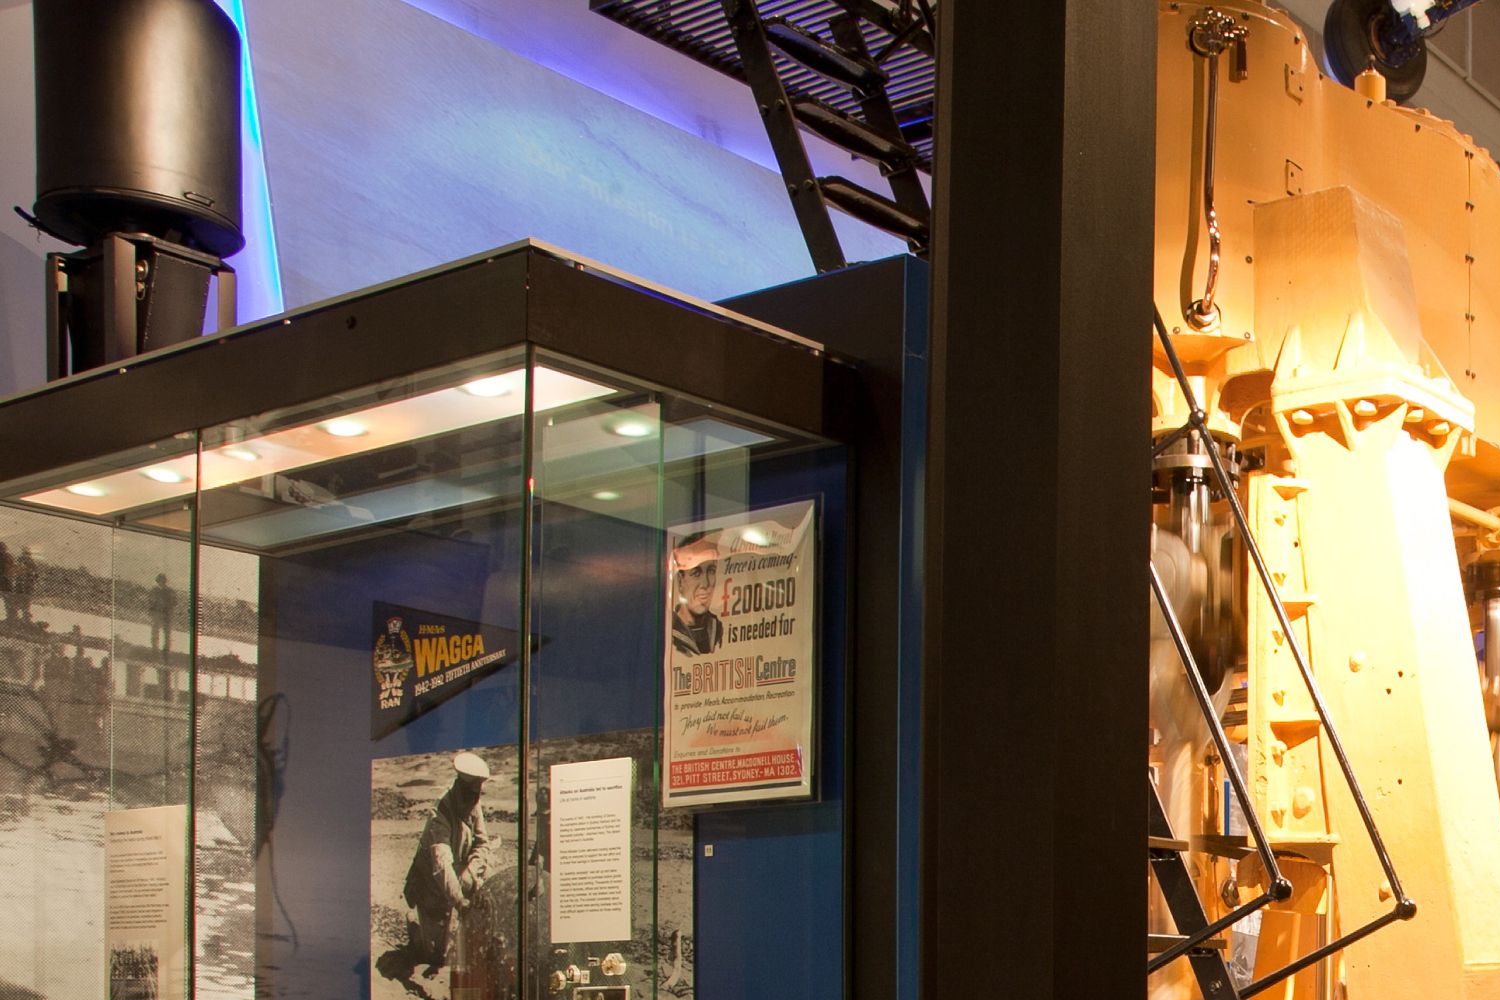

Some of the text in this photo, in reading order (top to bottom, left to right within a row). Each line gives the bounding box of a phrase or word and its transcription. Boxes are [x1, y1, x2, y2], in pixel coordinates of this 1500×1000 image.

[728, 613, 796, 644] is needed for
[413, 634, 485, 678] WAGGA
[445, 662, 471, 683] FIFTIETH
[673, 655, 796, 695] The BRITISH Centre
[380, 697, 400, 710] RAN
[680, 714, 702, 737] They
[702, 710, 717, 723] did
[717, 711, 730, 720] not
[719, 727, 739, 737] must
[671, 764, 683, 777] THE
[683, 761, 710, 774] BRITISH
[685, 773, 700, 785] PITT
